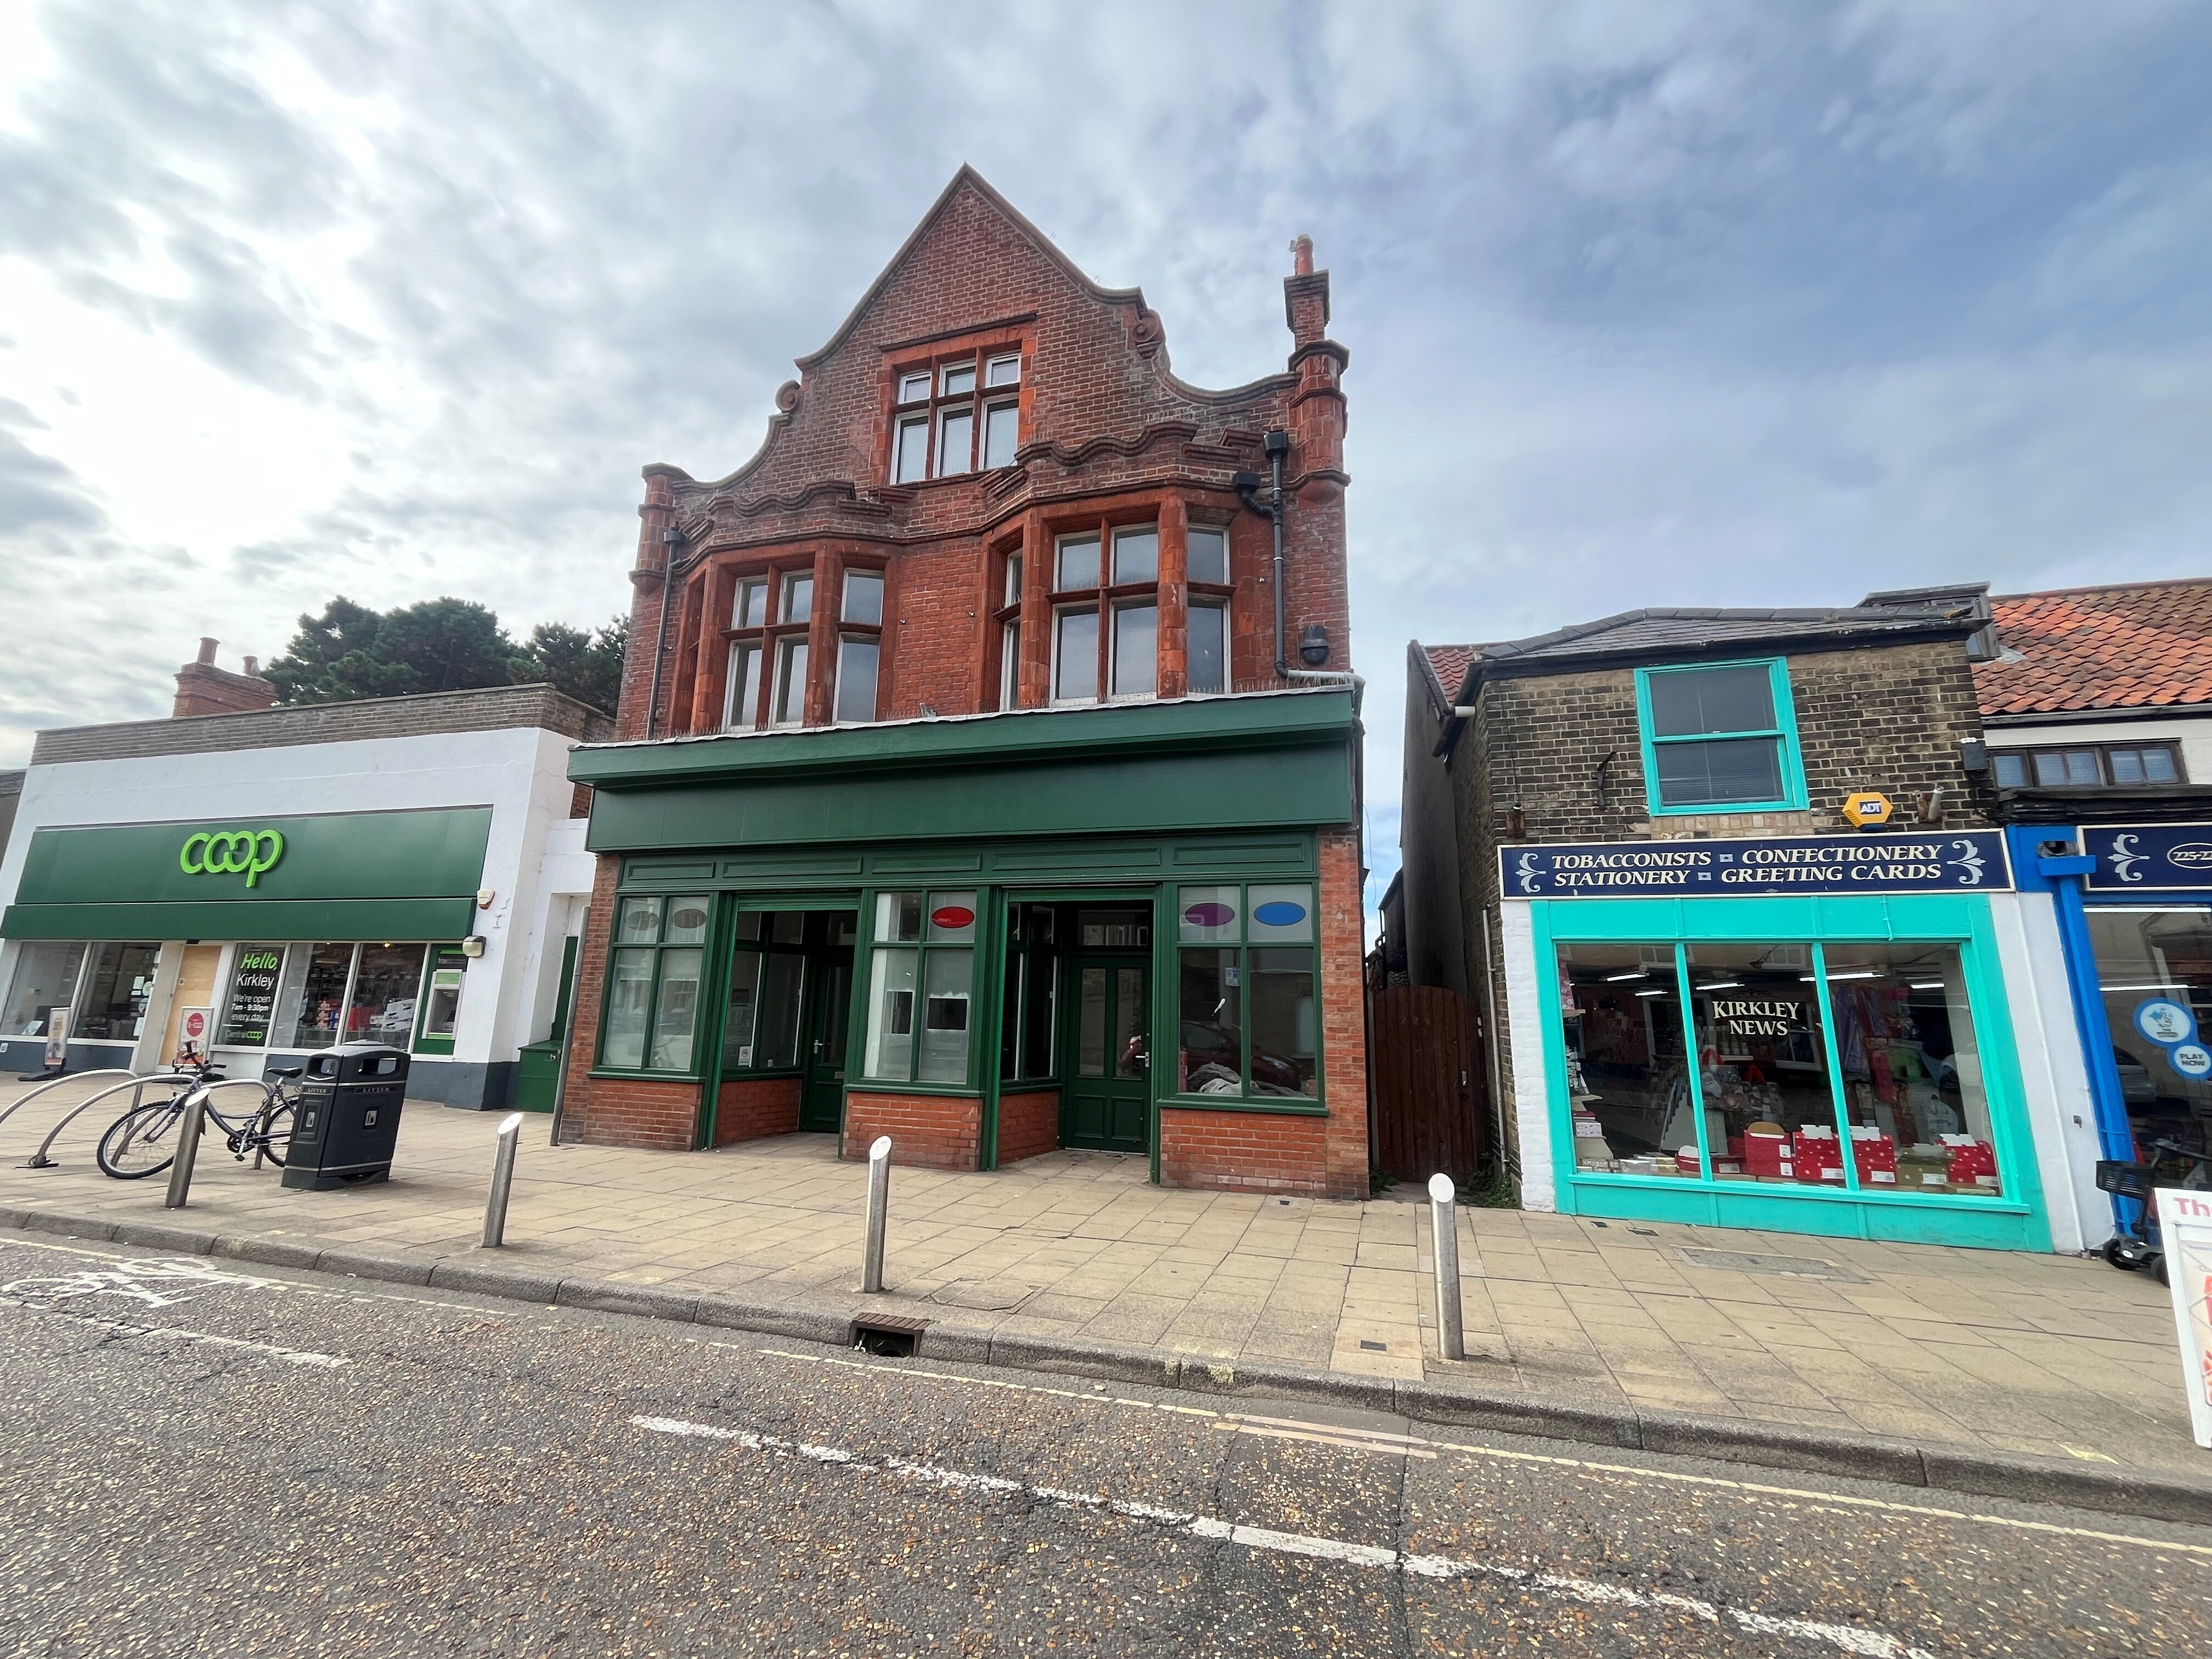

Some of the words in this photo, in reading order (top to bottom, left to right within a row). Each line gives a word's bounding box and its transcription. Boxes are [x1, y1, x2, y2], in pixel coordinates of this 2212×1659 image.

[1860, 803, 1882, 814] ADT
[180, 829, 283, 888] coop
[1551, 851, 1711, 869] TOBACCONISTS
[1741, 845, 1943, 865] CONFECTIONERY
[1554, 870, 1690, 887] STATIONERY
[1720, 866, 1843, 883] GREETING
[1851, 864, 1941, 880] CARDS
[236, 974, 275, 990] Kirkley
[253, 996, 270, 1004] open
[1712, 1001, 1799, 1020] KIRKLEY
[1729, 1020, 1788, 1036] NEWS
[2173, 1198, 2212, 1217] Th
